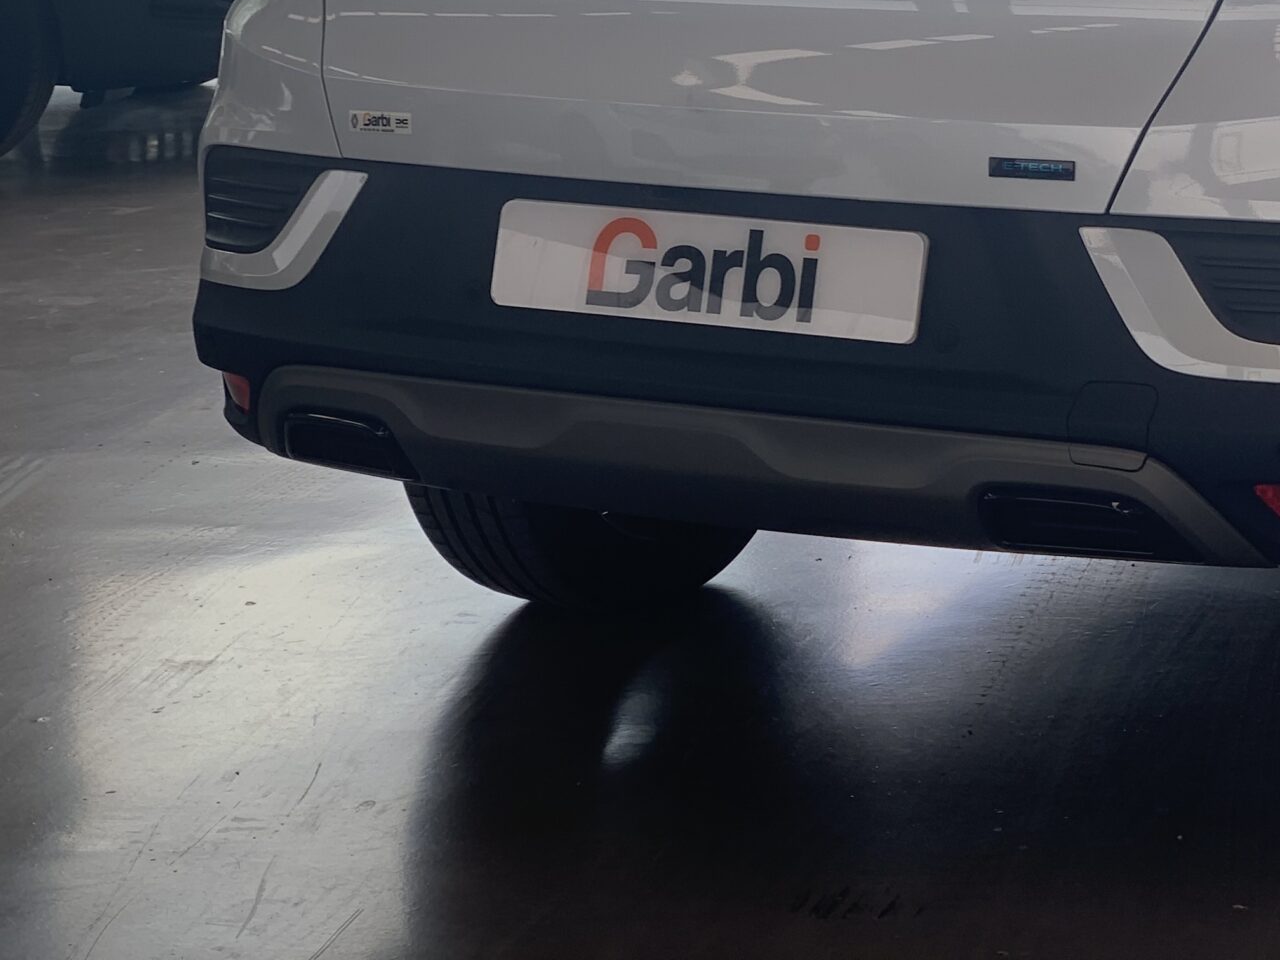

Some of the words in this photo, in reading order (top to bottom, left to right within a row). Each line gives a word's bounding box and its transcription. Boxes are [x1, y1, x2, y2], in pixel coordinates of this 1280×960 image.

[362, 112, 392, 128] Garbi
[1002, 160, 1064, 173] E-TECH
[585, 216, 821, 324] Garbi
